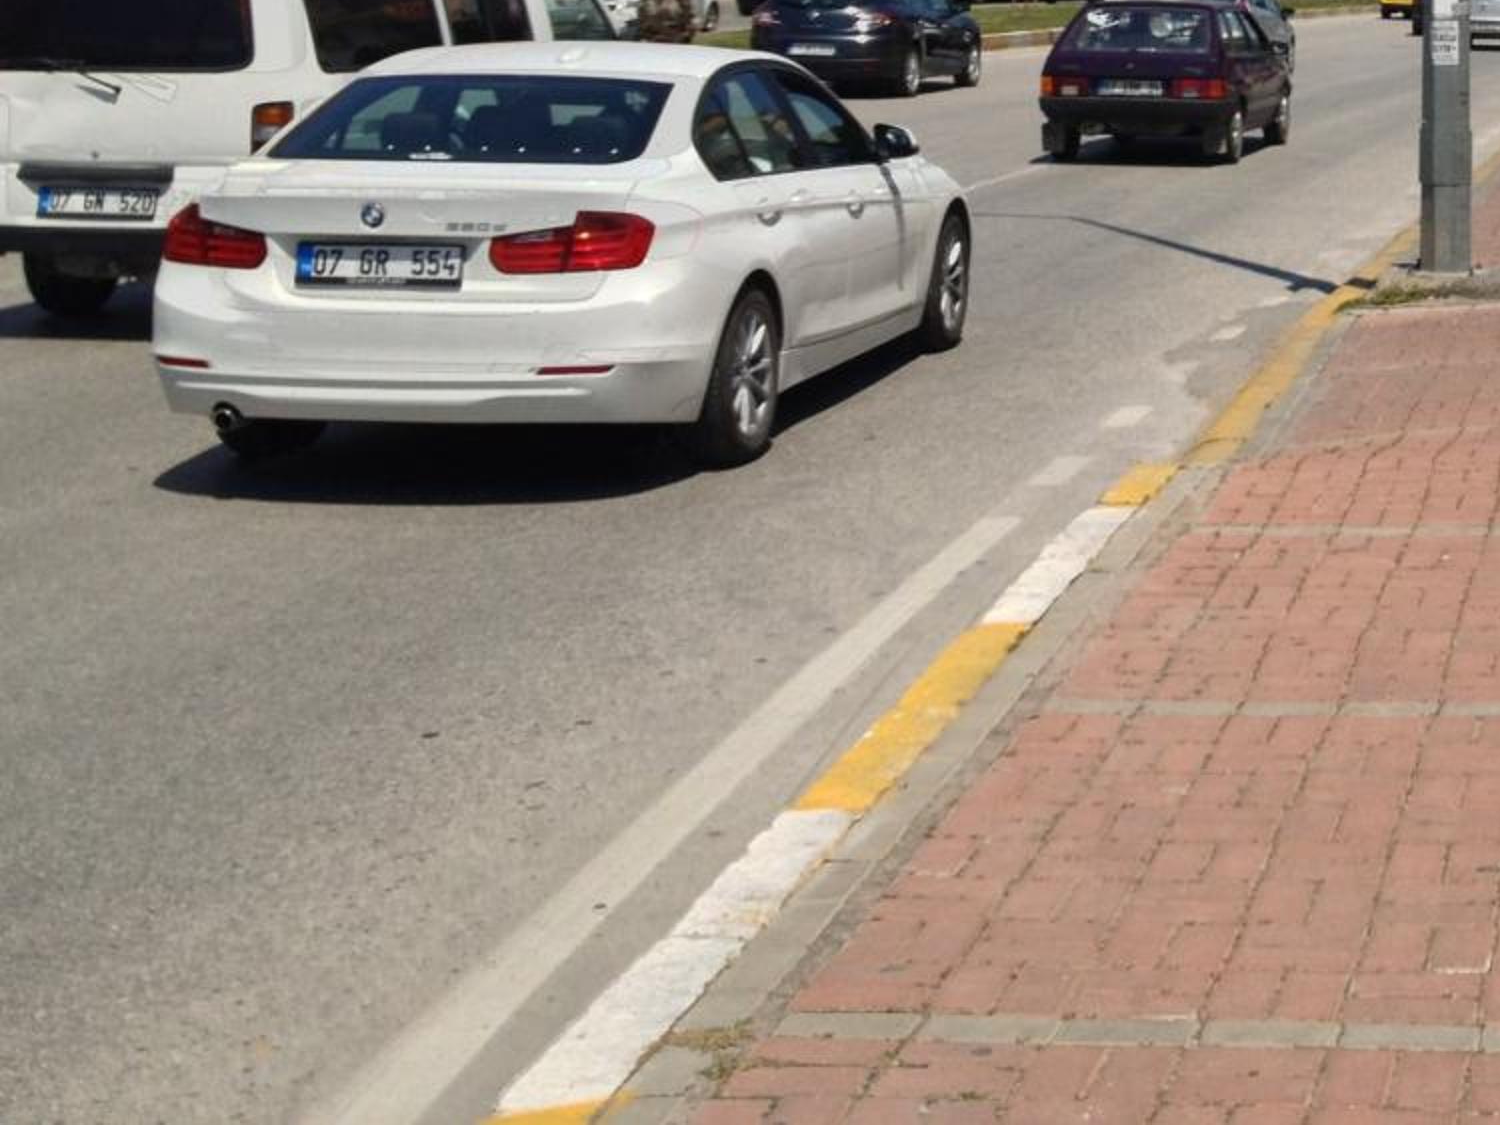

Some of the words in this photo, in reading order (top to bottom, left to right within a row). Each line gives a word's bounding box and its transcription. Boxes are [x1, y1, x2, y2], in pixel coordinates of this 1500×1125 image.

[313, 249, 343, 275] 07
[359, 249, 389, 275] GR
[411, 251, 456, 276] 554
